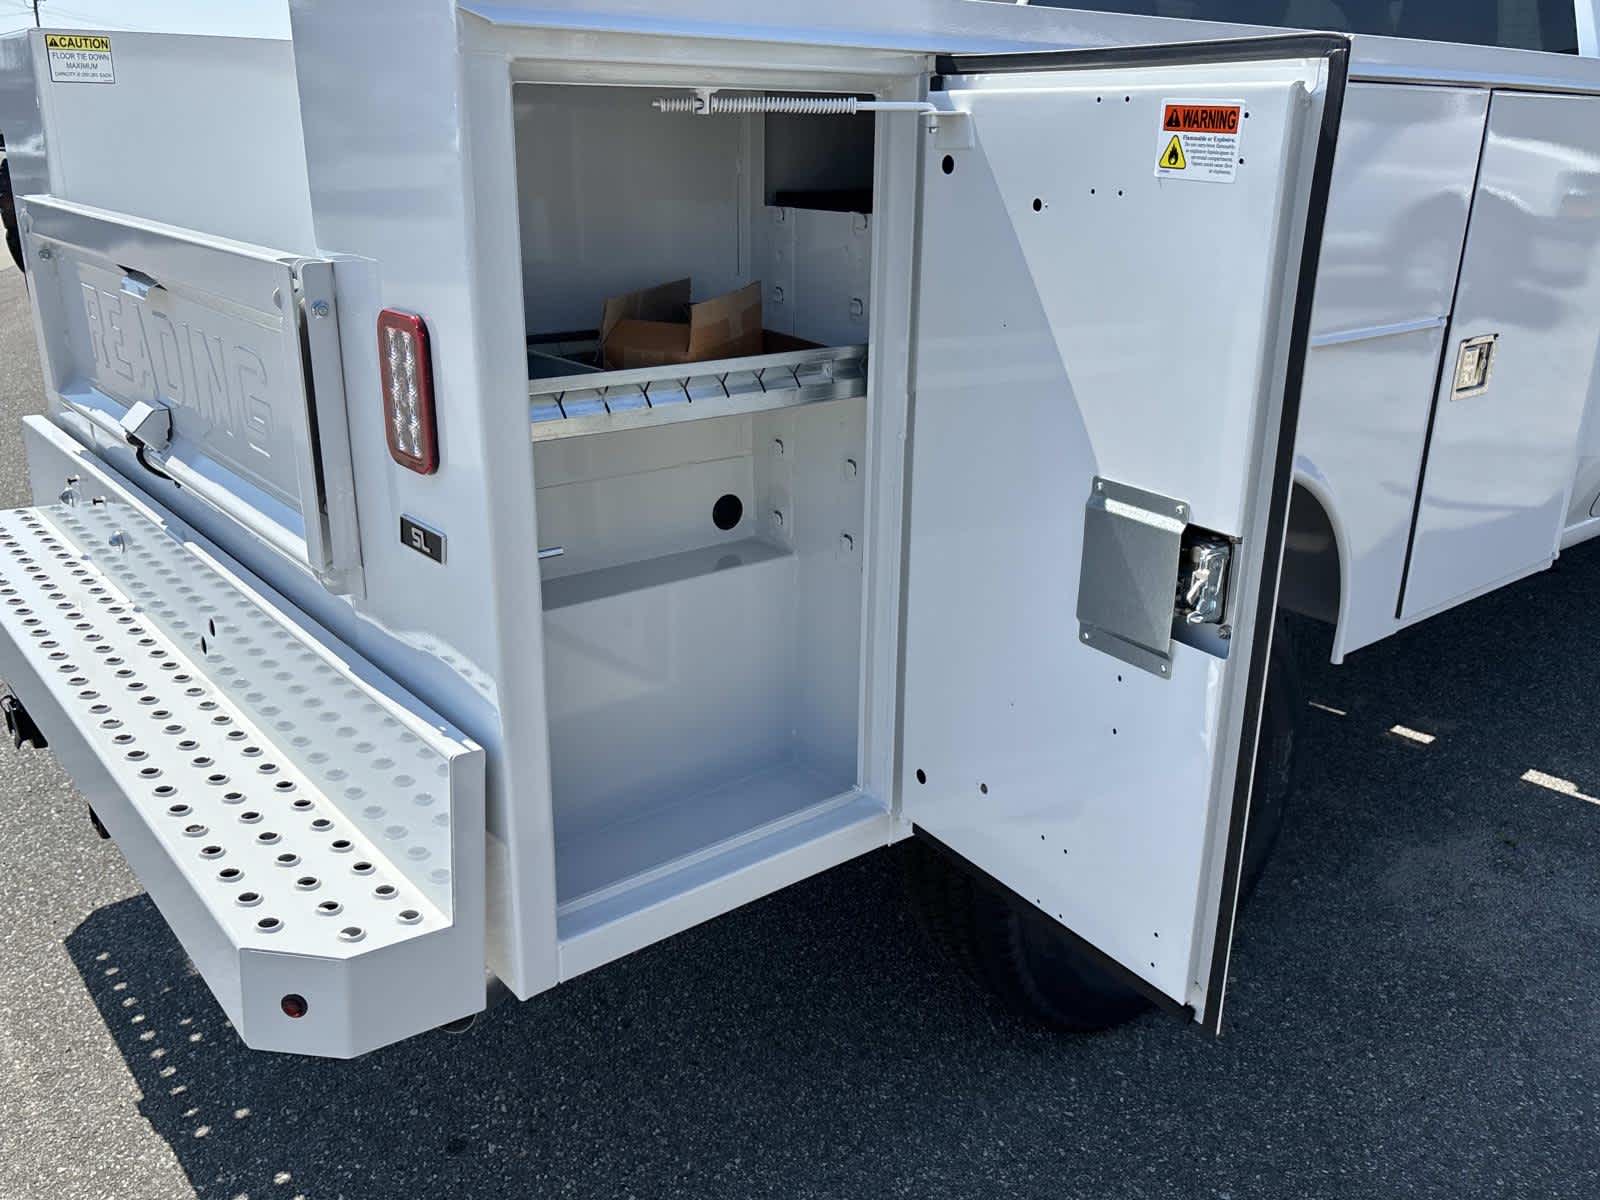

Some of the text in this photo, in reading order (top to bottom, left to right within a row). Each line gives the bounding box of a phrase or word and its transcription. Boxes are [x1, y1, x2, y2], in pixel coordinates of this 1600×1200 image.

[60, 37, 109, 49] CAUTION
[66, 62, 98, 70] MAXIMUM
[1183, 108, 1237, 130] WARNING
[411, 526, 431, 553] SL
